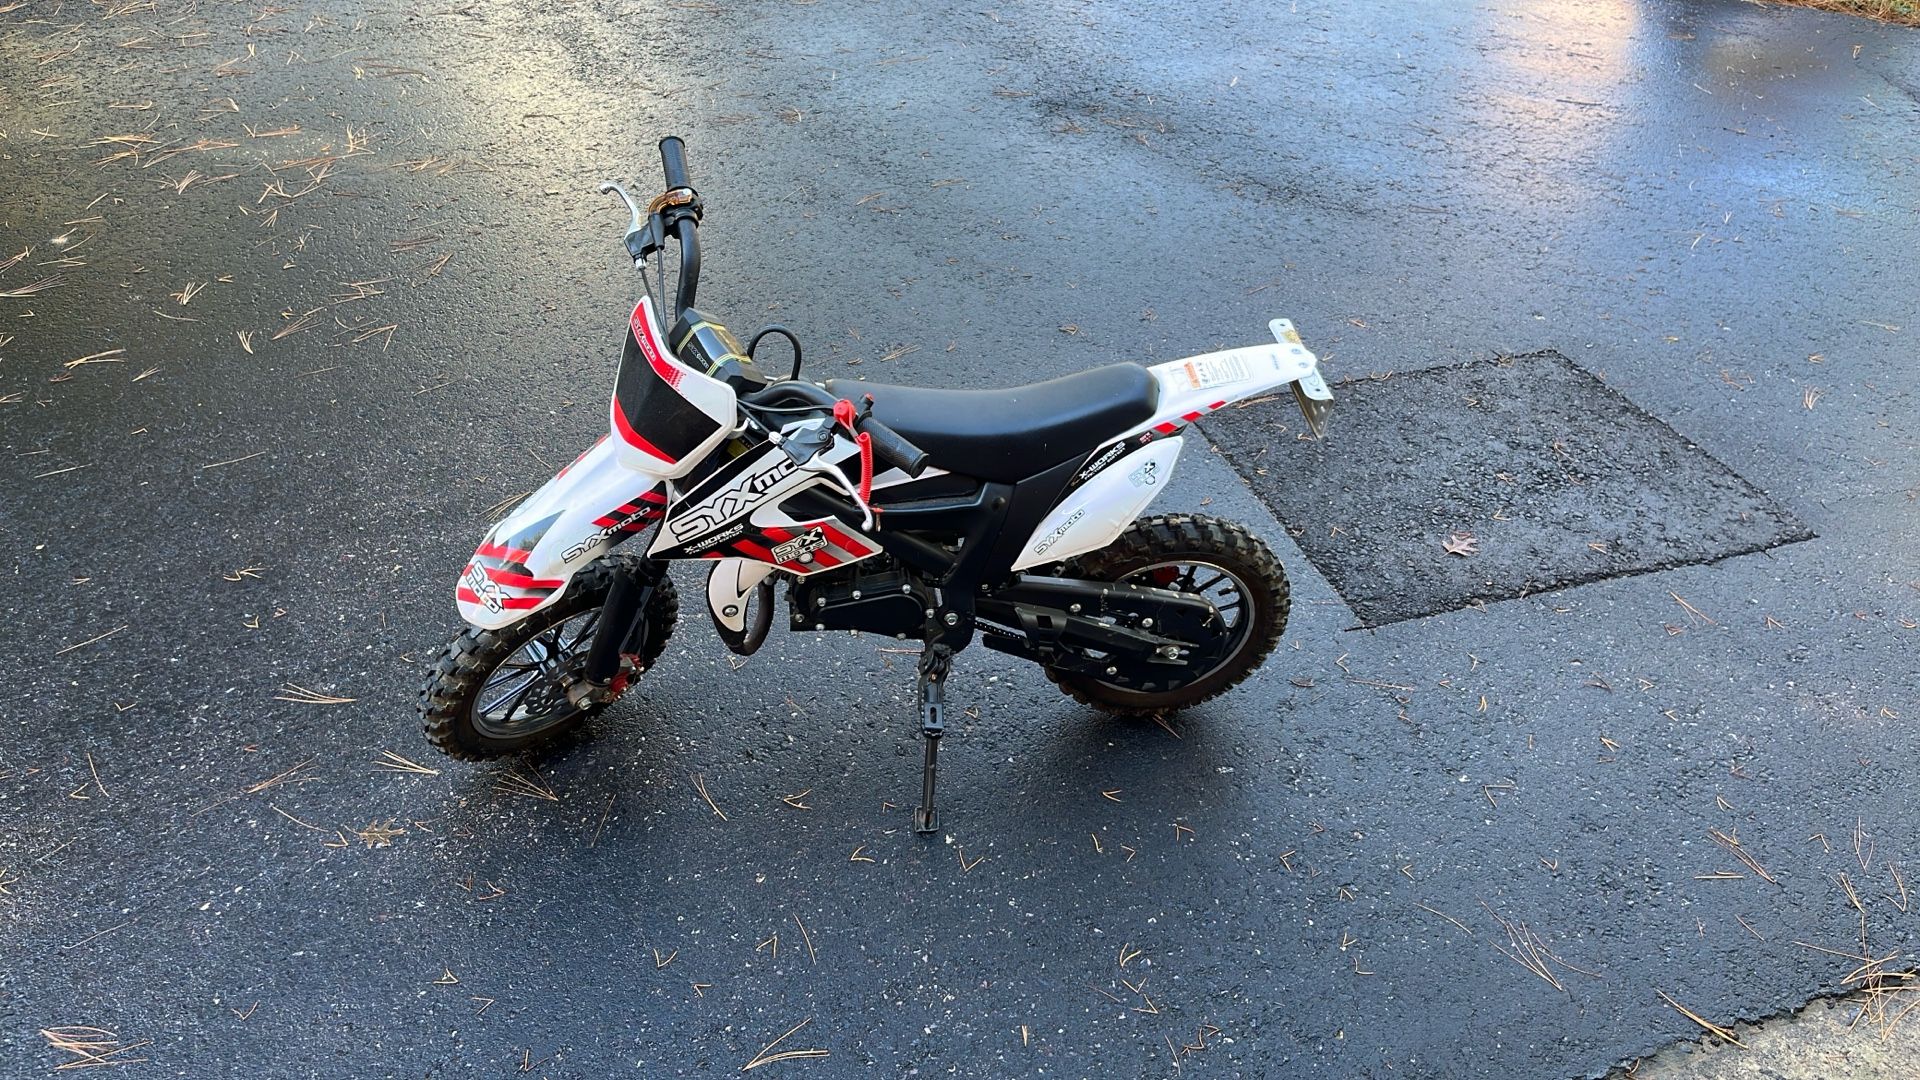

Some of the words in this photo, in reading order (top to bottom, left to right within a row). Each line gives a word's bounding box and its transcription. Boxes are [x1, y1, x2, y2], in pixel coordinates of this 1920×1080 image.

[561, 506, 651, 564] SYXmoto
[683, 523, 744, 554] X-WORKS
[1033, 508, 1086, 556] SYXmoto
[472, 561, 512, 611] SYX
